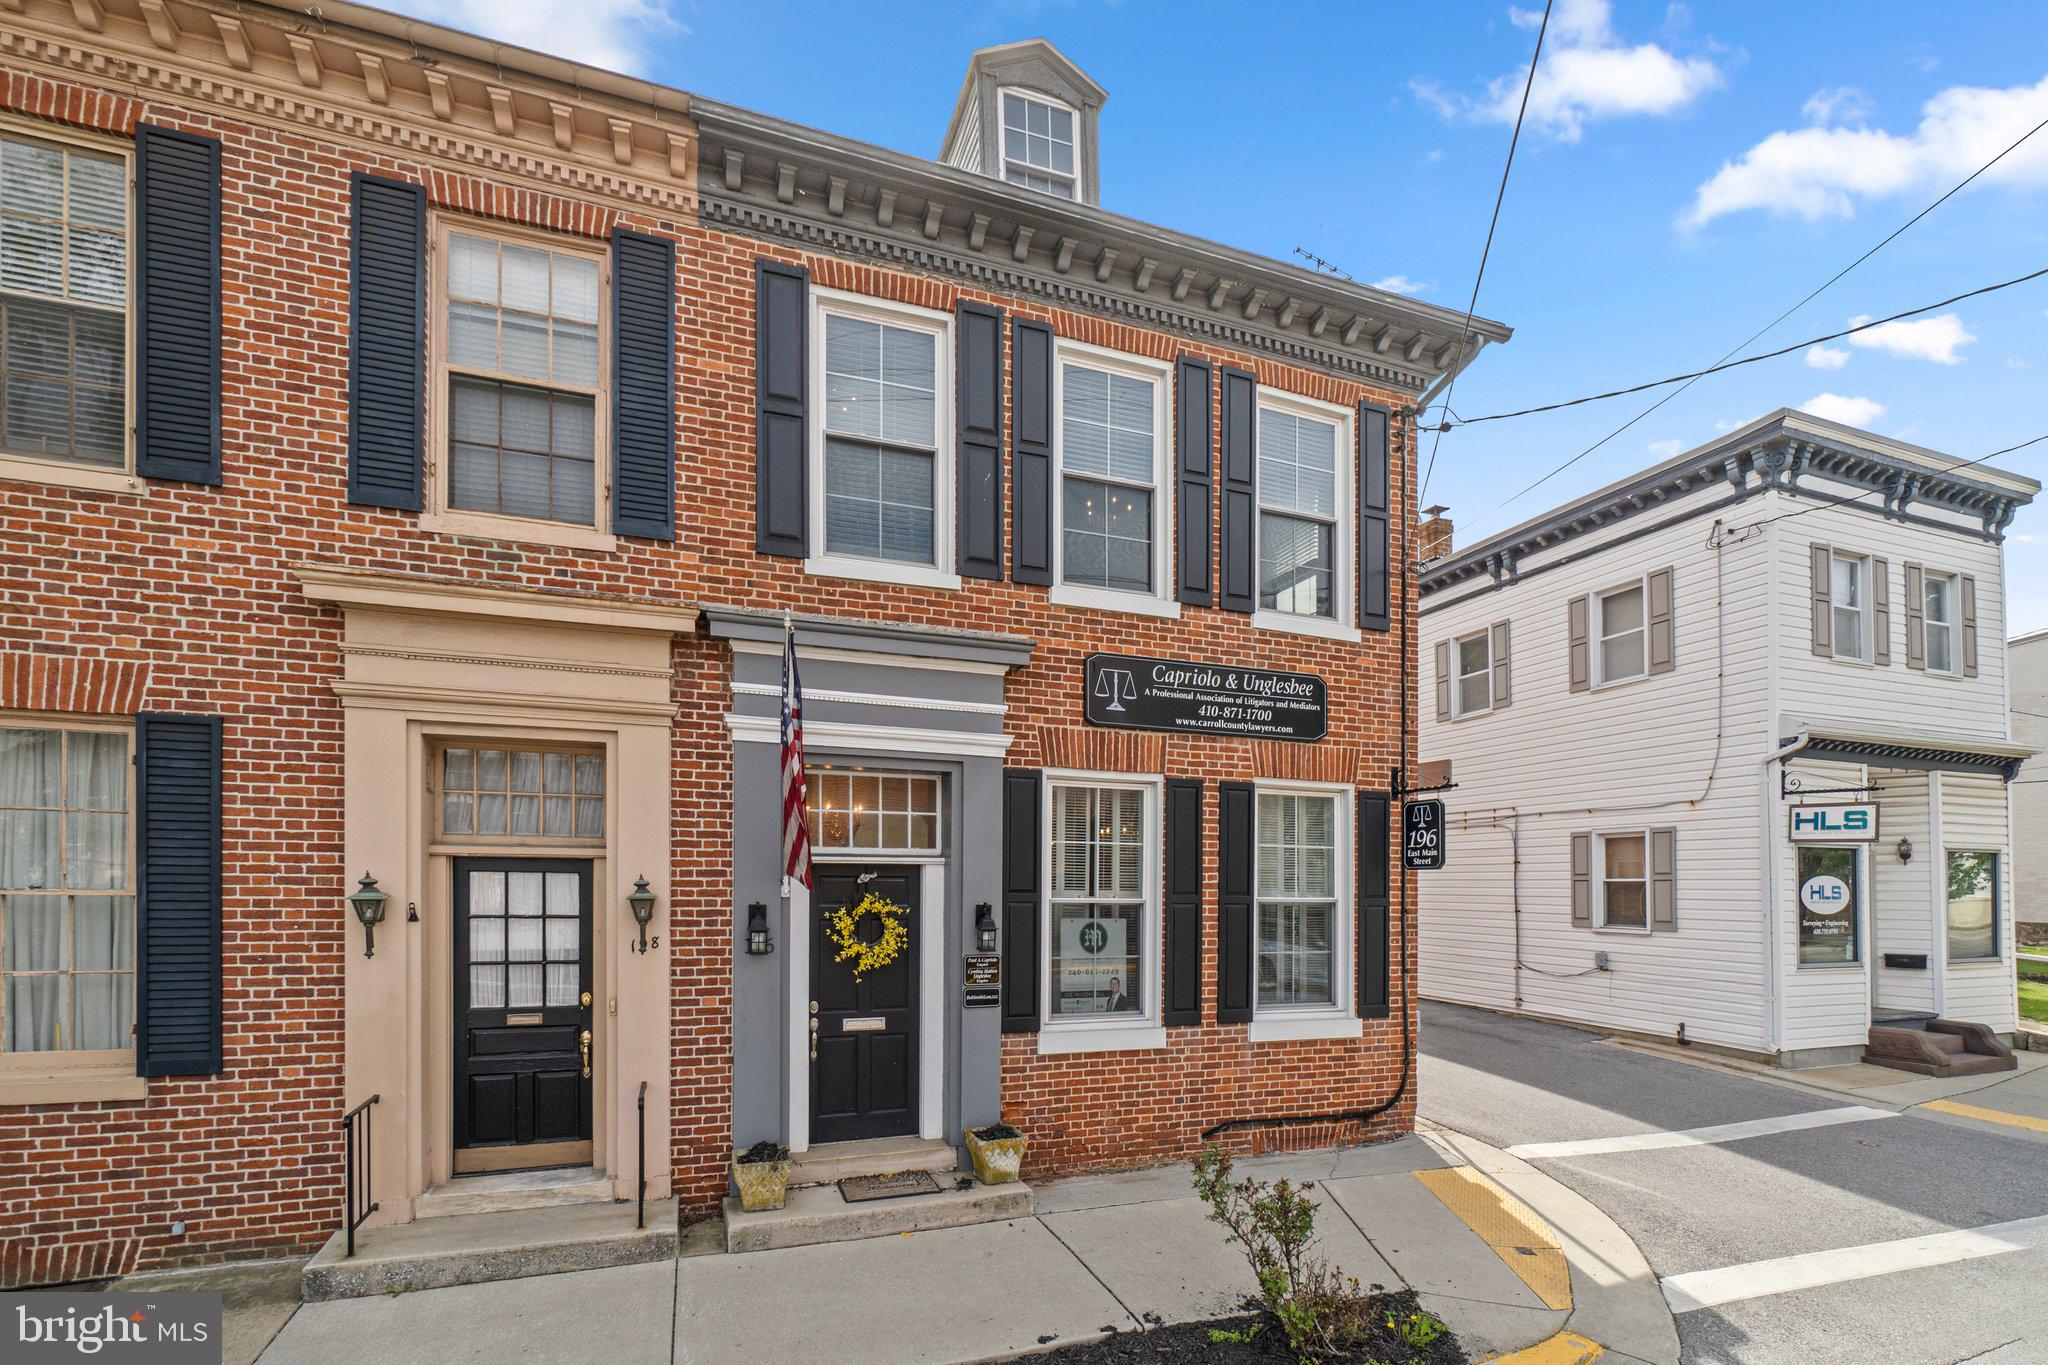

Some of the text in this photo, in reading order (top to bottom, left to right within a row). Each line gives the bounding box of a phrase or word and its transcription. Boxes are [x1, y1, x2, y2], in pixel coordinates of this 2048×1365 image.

[1152, 665, 1313, 697] Capriolo & Unglesbee
[1144, 688, 1321, 711] A Professional Association of Litigators and Mediators
[1198, 704, 1272, 721] 410-871-1700
[1175, 718, 1293, 734] www.carrollcountylawyers.com
[1794, 810, 1869, 831] HLS
[1407, 828, 1438, 848] 196
[1407, 848, 1438, 857] East Main
[1413, 857, 1432, 865] Street
[1810, 885, 1842, 900] HLS
[631, 936, 660, 954] 18
